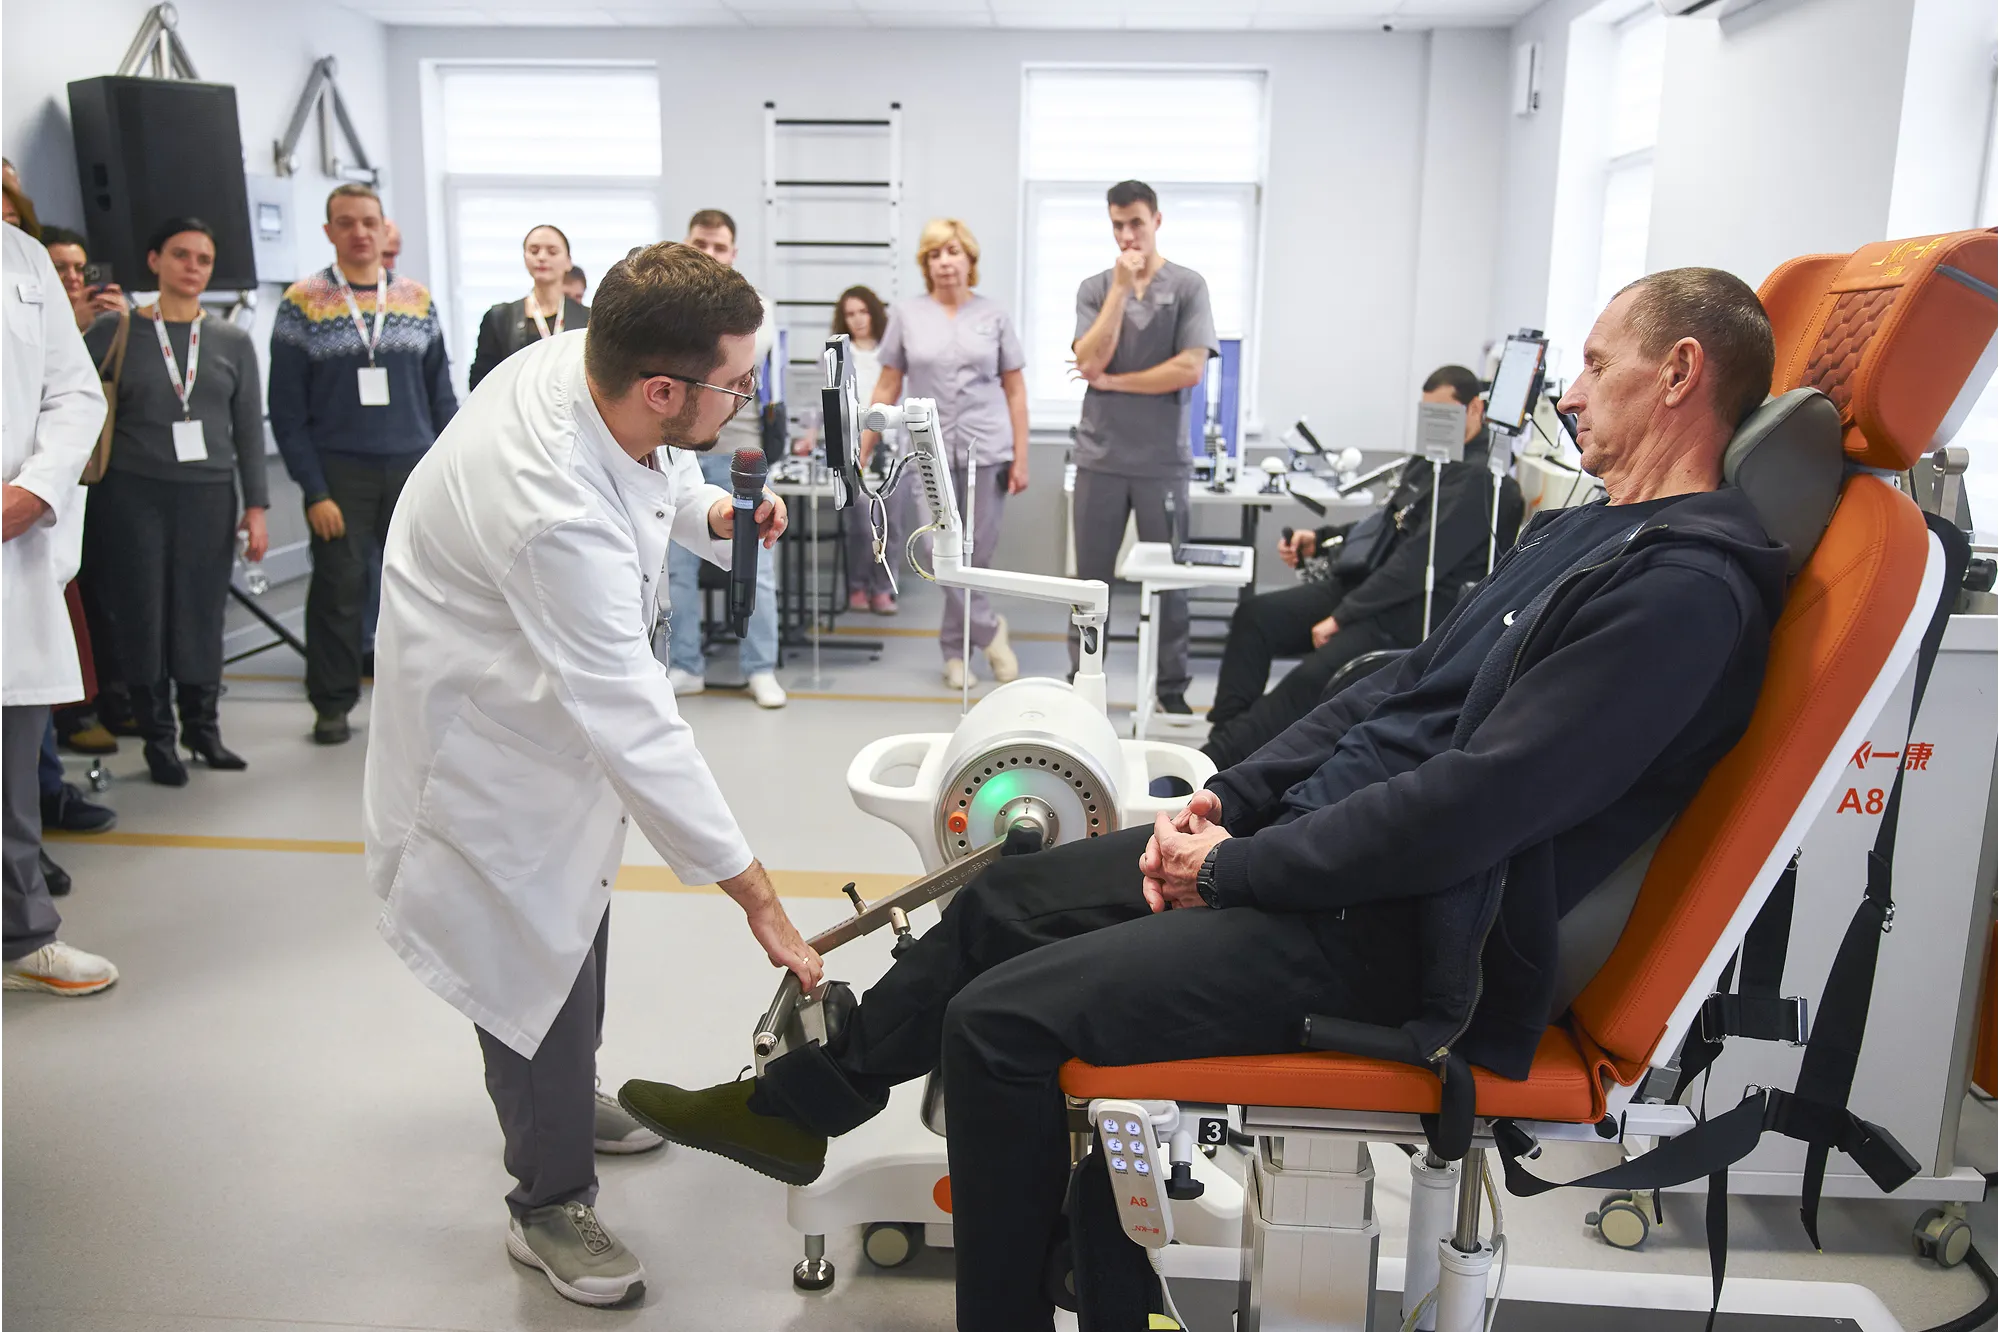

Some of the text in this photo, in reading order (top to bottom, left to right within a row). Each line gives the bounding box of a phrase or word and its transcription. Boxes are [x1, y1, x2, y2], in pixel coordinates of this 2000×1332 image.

[1836, 788, 1885, 815] A8
[1206, 1121, 1222, 1142] 3
[1130, 1196, 1148, 1208] A8
